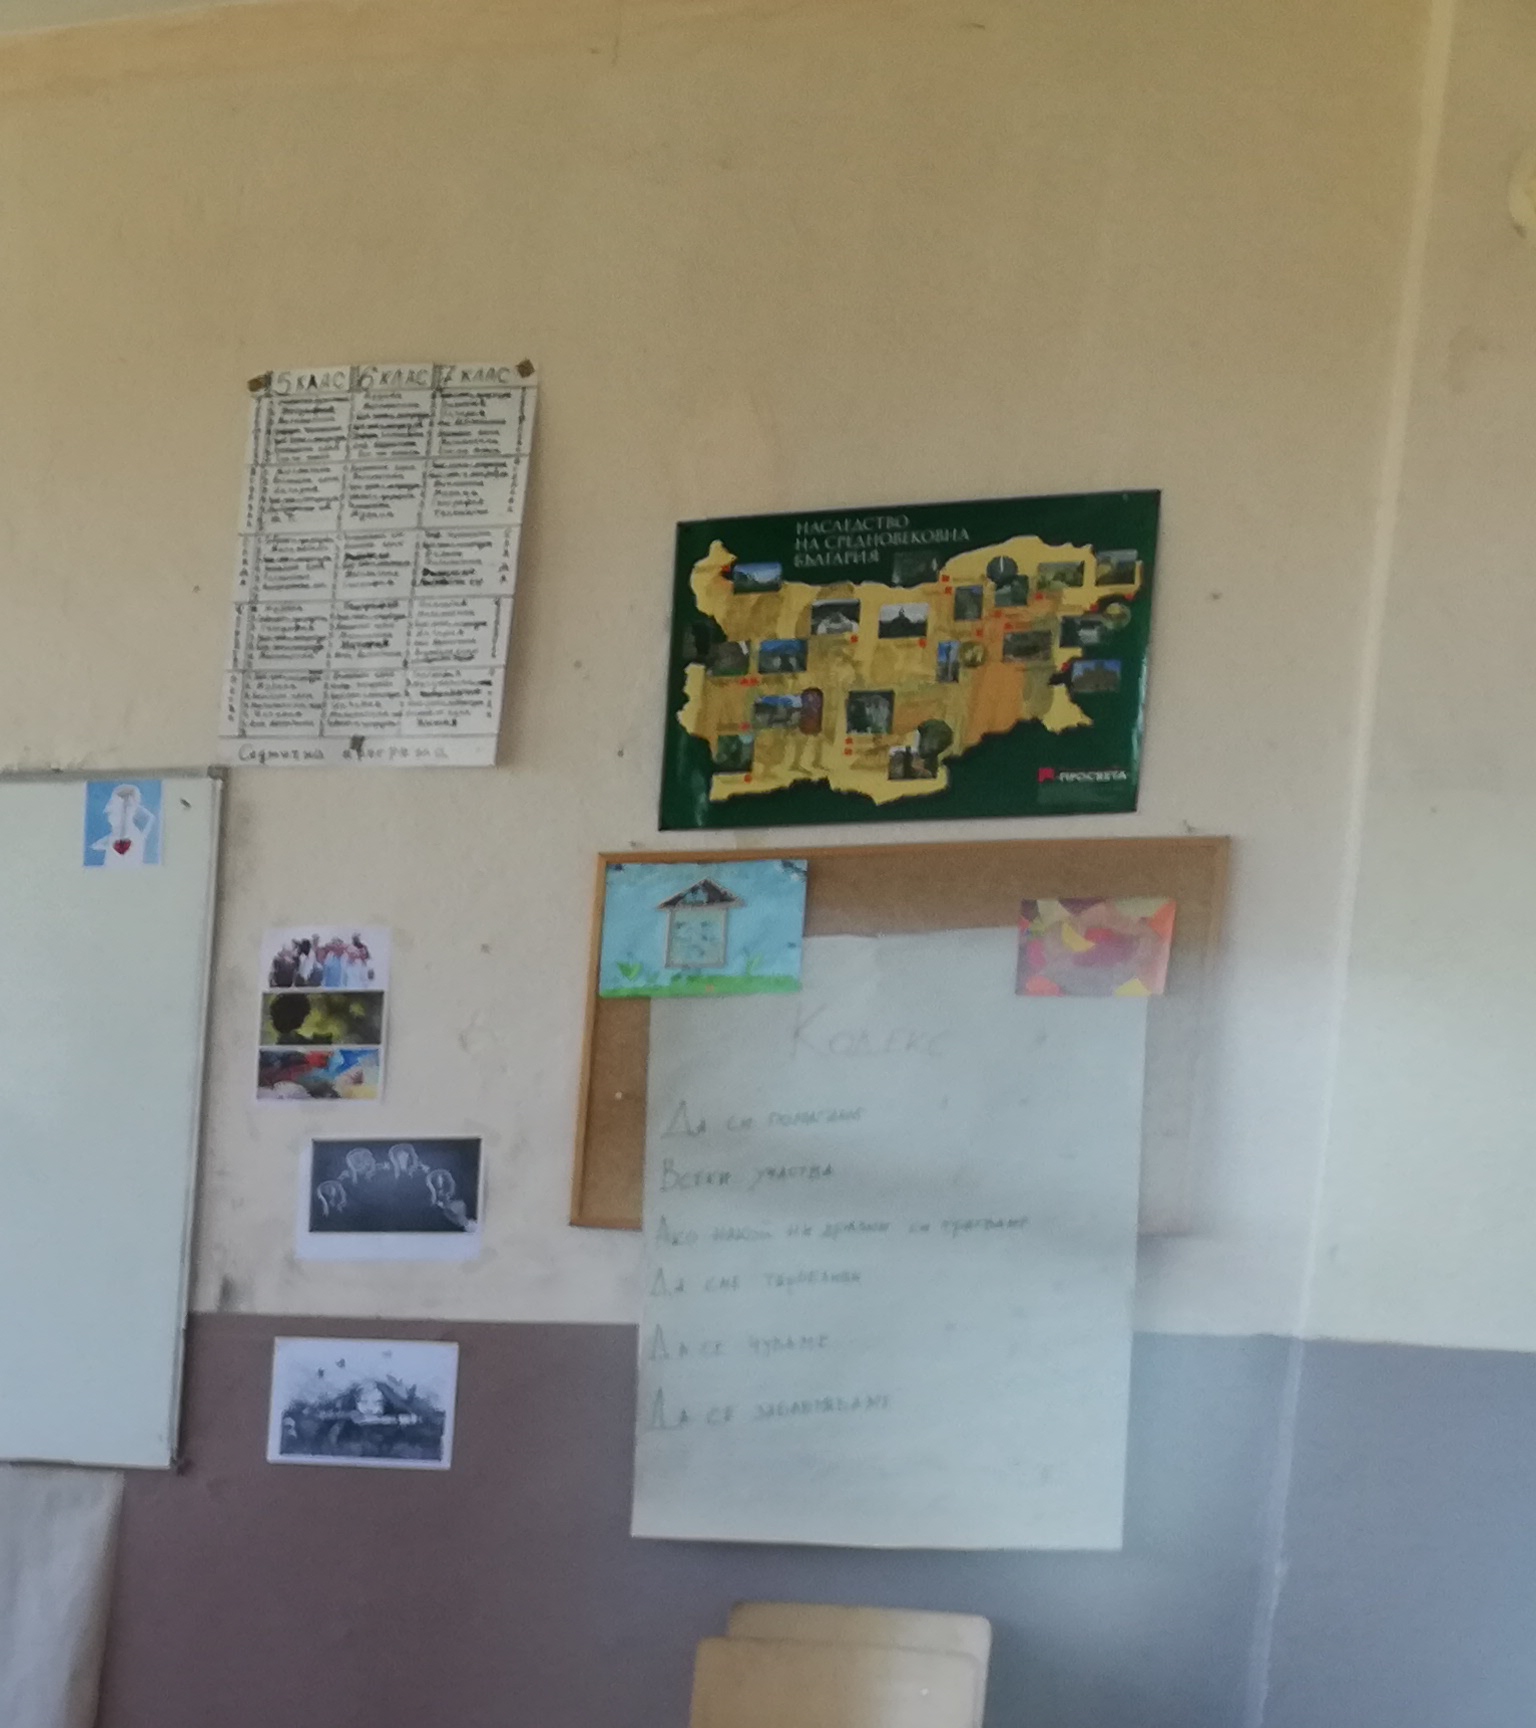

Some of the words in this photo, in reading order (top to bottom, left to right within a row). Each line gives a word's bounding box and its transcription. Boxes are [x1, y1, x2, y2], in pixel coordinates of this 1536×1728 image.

[796, 513, 910, 536] НАСЛЕДСТВО
[794, 536, 820, 552] НА
[824, 527, 970, 550] СРЕДНОВЕКОВНА
[793, 549, 880, 568] БЪЛГАРИЯ
